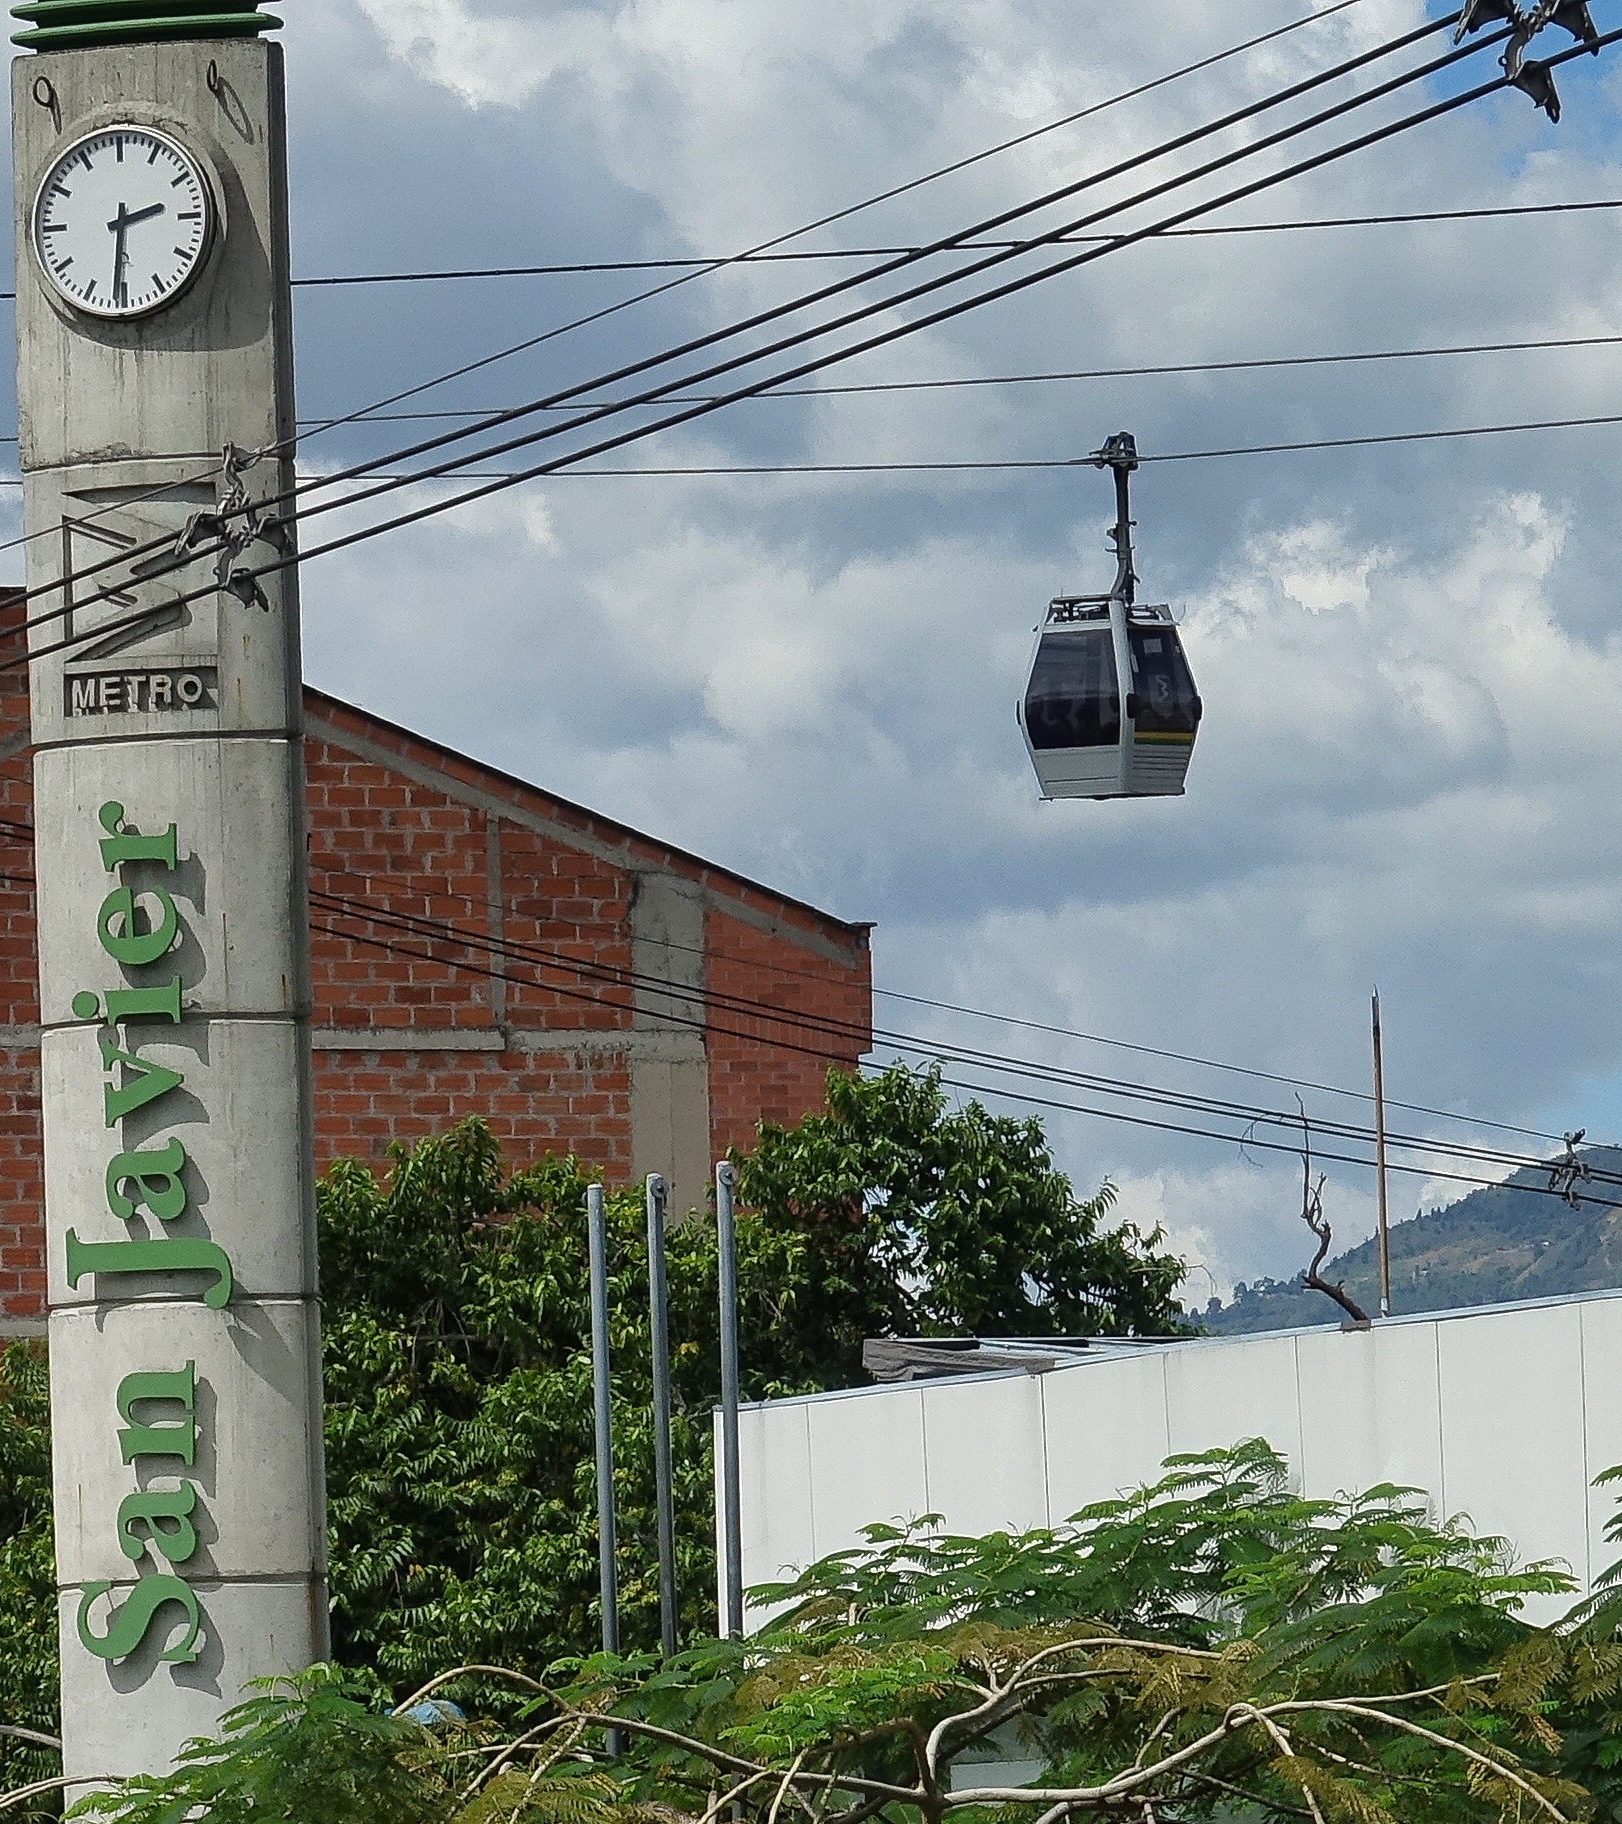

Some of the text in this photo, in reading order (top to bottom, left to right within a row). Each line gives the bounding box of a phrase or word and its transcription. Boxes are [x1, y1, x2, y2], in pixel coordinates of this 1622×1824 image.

[72, 672, 204, 709] METRO
[66, 801, 234, 1664] San Javier
